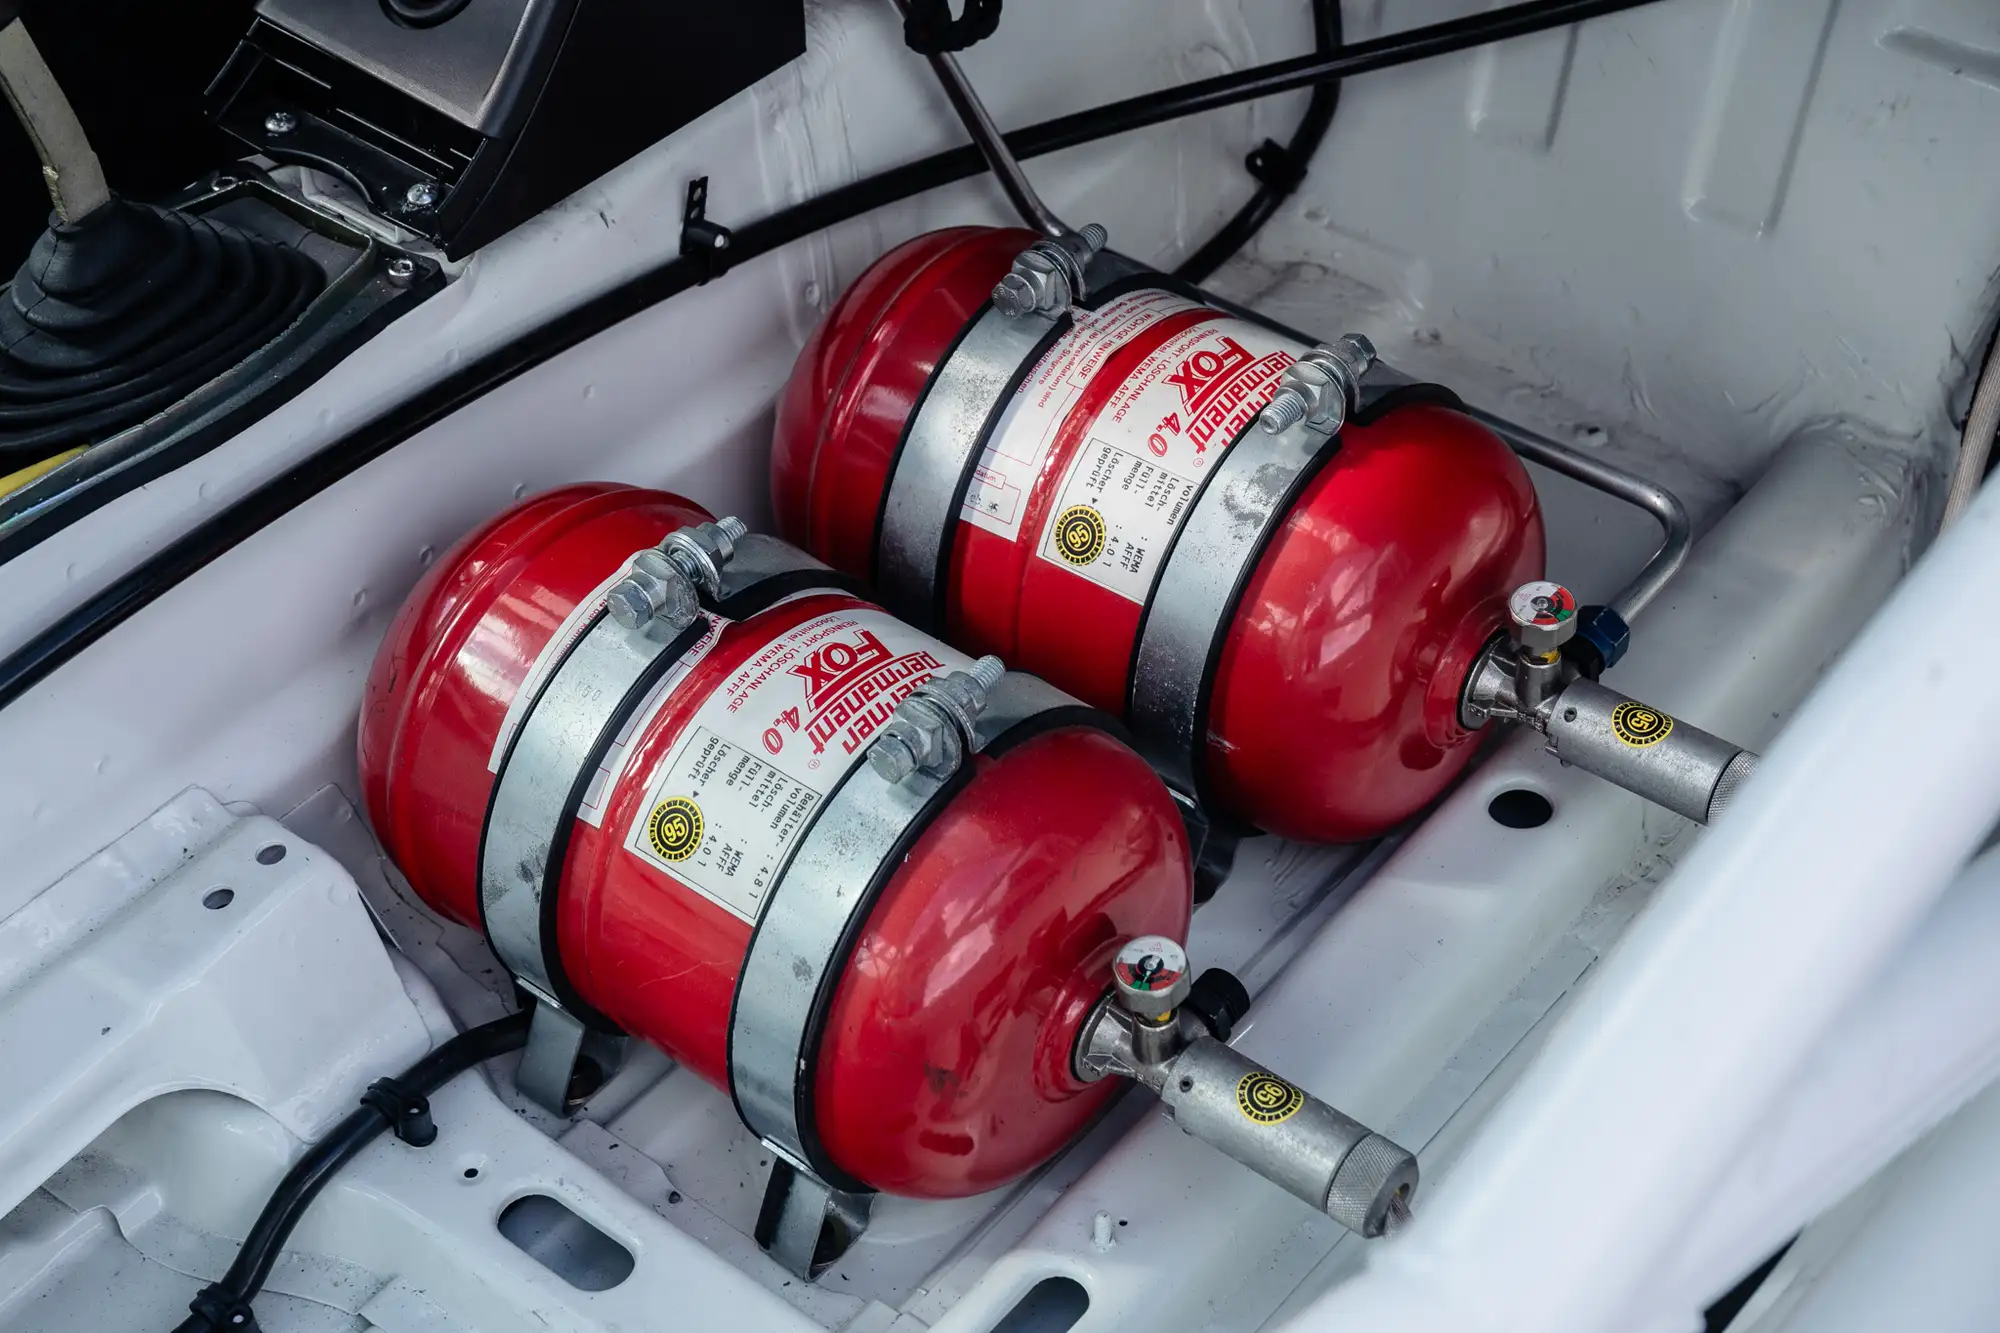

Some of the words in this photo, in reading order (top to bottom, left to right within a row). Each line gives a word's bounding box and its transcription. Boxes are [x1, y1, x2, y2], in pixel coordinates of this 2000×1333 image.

[1112, 312, 1153, 341] WICHTIGE
[1038, 348, 1071, 385] Steigrohre
[1079, 339, 1116, 380] HINWEISE
[1037, 391, 1051, 408] sind
[1188, 350, 1297, 455] permanent
[1147, 412, 1181, 457] 4.0
[1086, 446, 1112, 489] geprüft
[1096, 452, 1123, 493] Löscher
[1122, 460, 1142, 490] menge
[1134, 466, 1154, 494] Füll-
[1145, 472, 1168, 508] mittel
[1156, 477, 1180, 511] Lösch-
[1167, 484, 1194, 526] volumen
[1068, 524, 1090, 549] 95
[1108, 536, 1119, 556] 4.0
[1120, 542, 1135, 569] AFFF
[1129, 547, 1146, 574] WEMA
[784, 615, 841, 644] Löschmittel:
[807, 651, 946, 756] permanent
[762, 706, 801, 755] 4.0
[1631, 711, 1654, 730] 95
[687, 736, 720, 780] geprüft
[698, 743, 731, 787] Löscher
[725, 755, 750, 786] menge
[738, 761, 762, 791] Füll-
[748, 770, 776, 808] mittel
[761, 777, 788, 813] Lösch-
[770, 787, 803, 830] volumen
[663, 817, 686, 843] 95
[776, 793, 814, 848] Behälter-
[703, 835, 718, 856] 4.0
[716, 842, 733, 872] AFFF
[725, 850, 744, 877] WEMA
[754, 866, 769, 888] 4.8
[1256, 1082, 1286, 1105] 95
